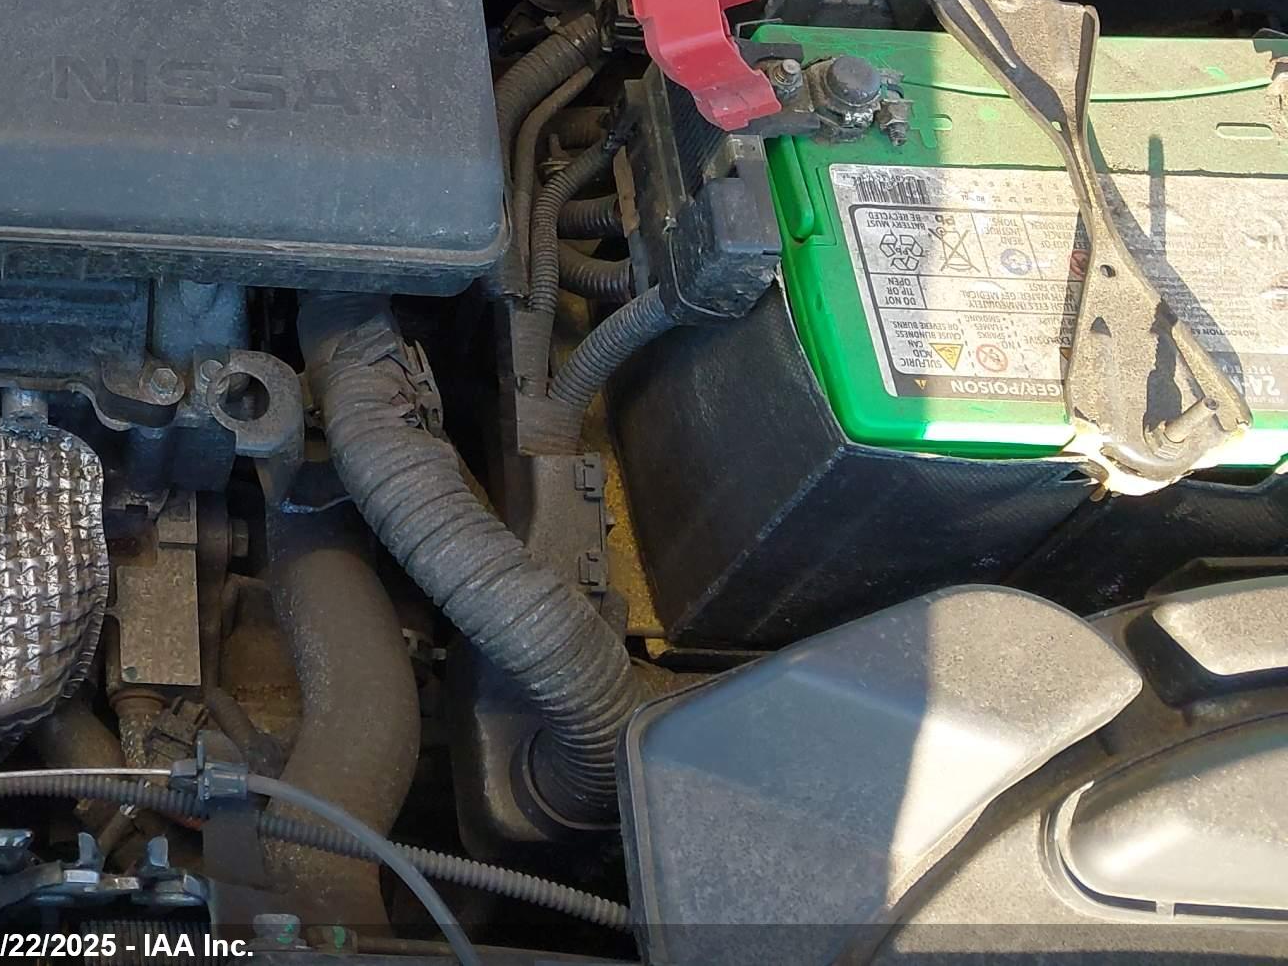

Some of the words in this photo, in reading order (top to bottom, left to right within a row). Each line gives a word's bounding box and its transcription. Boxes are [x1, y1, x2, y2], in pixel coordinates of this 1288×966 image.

[51, 54, 434, 121] NISSAN
[909, 213, 922, 222] BE
[934, 215, 956, 226] Pb
[866, 219, 890, 228] MUST
[891, 221, 926, 231] BATTERY
[888, 276, 912, 287] OPEN
[886, 286, 900, 295] OR
[902, 286, 915, 296] TIP
[961, 289, 999, 300] MEDICAL
[884, 296, 902, 305] NOT
[903, 296, 917, 306] DO
[963, 314, 1001, 323] SMOKING
[919, 322, 946, 330] SEVERE
[974, 323, 1004, 331] FLAMES
[895, 330, 937, 339] BLINDNESS
[937, 331, 962, 340] CAUSE
[976, 331, 1006, 340] SPARKS
[907, 339, 924, 348] CAN
[912, 349, 933, 358] ACID
[898, 358, 943, 370] SULFURIC
